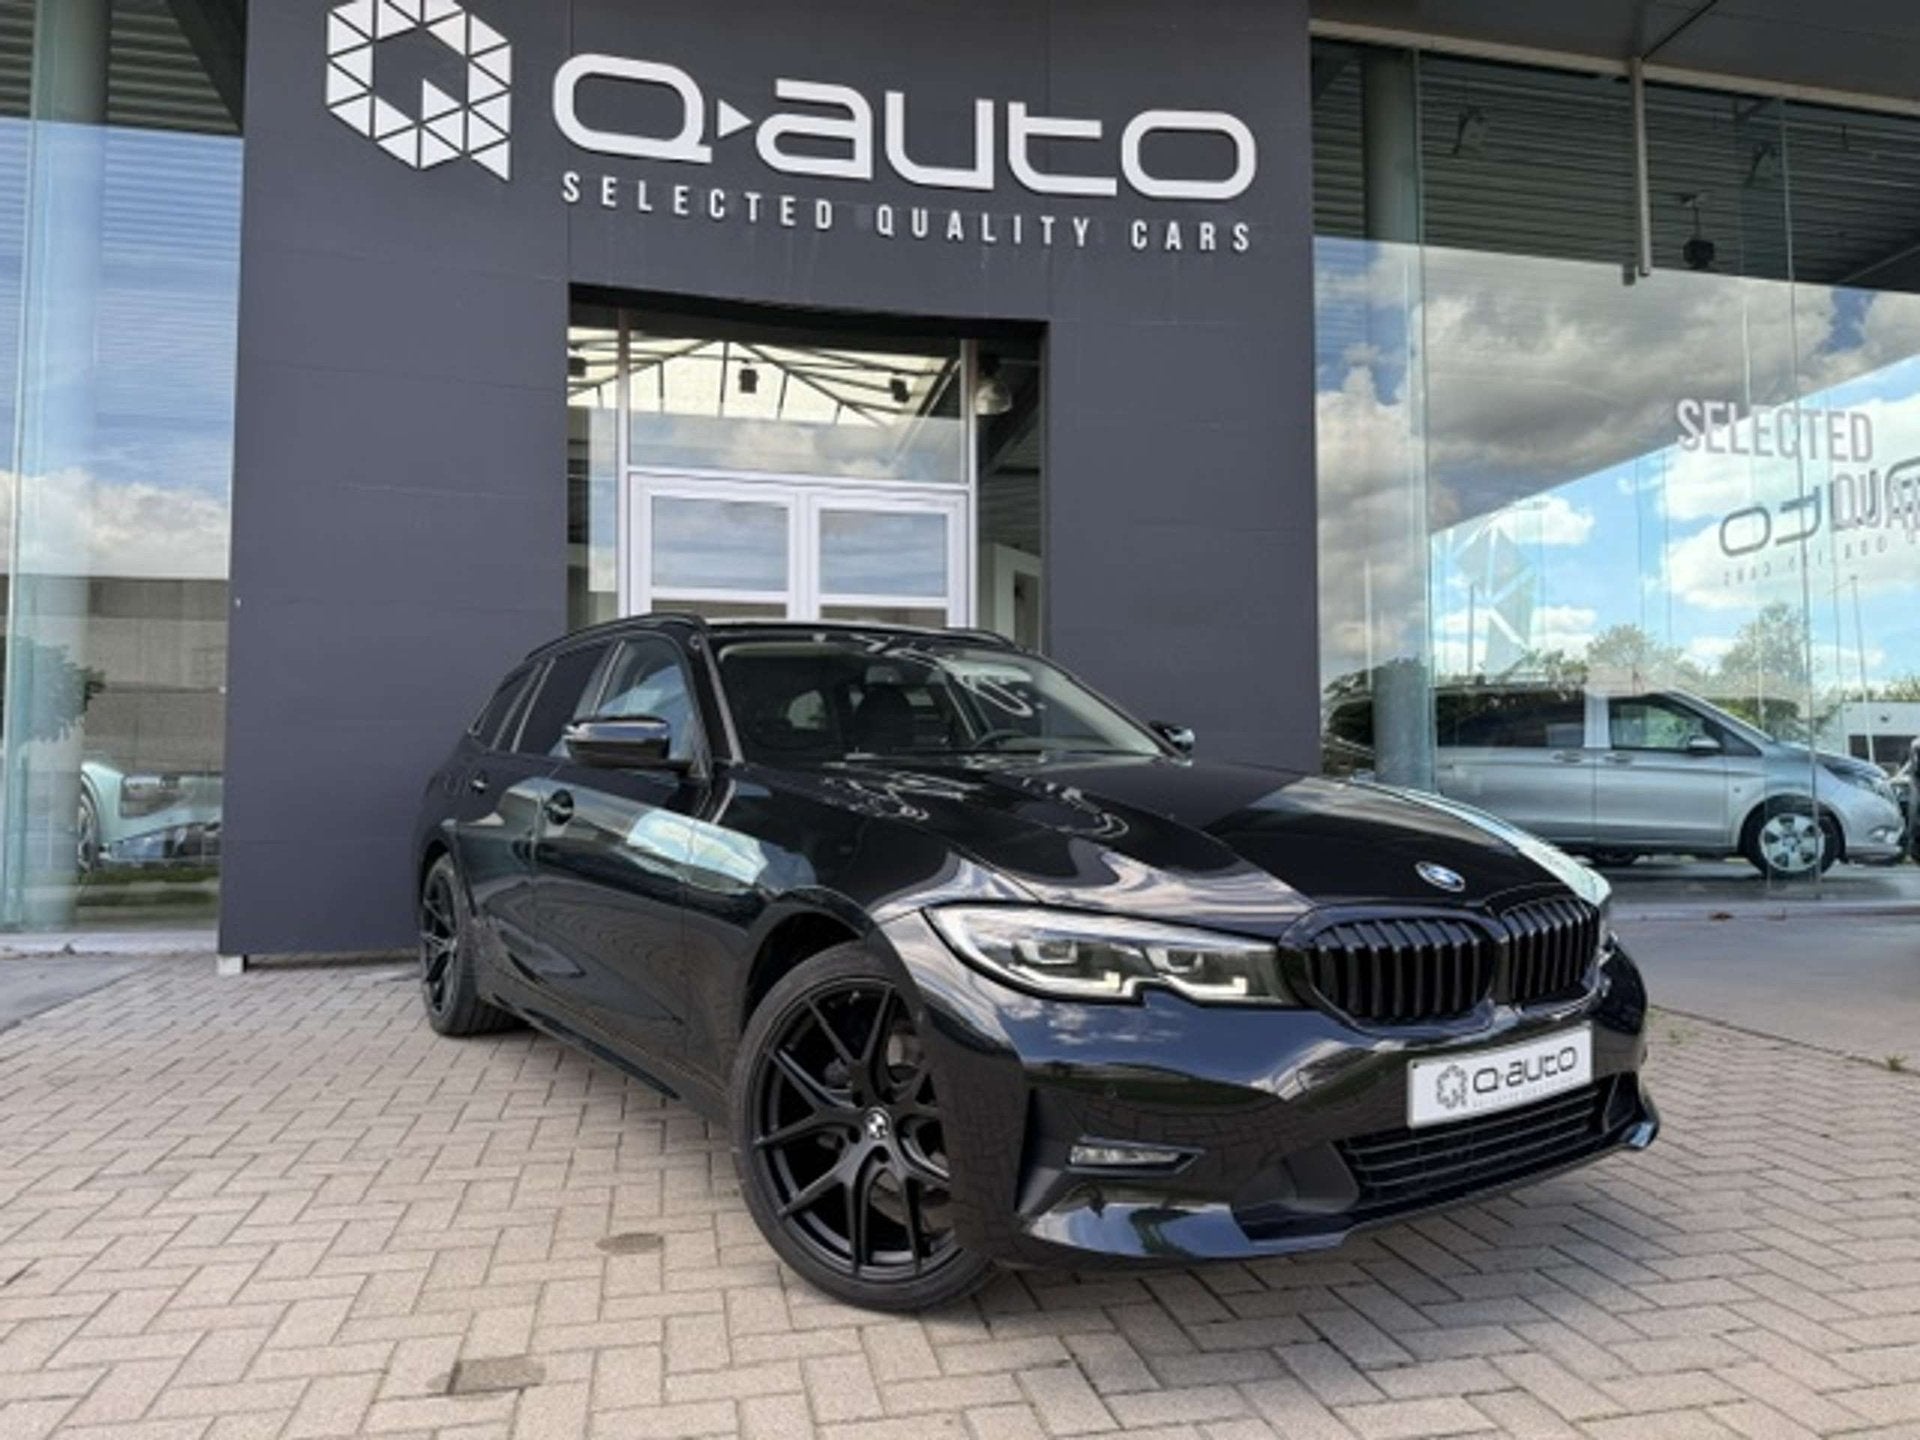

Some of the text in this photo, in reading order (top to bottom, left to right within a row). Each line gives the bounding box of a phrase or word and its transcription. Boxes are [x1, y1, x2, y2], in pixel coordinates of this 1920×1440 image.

[562, 171, 1250, 252] SELECTED QUALITY CARS
[1677, 398, 1873, 463] SELECTED
